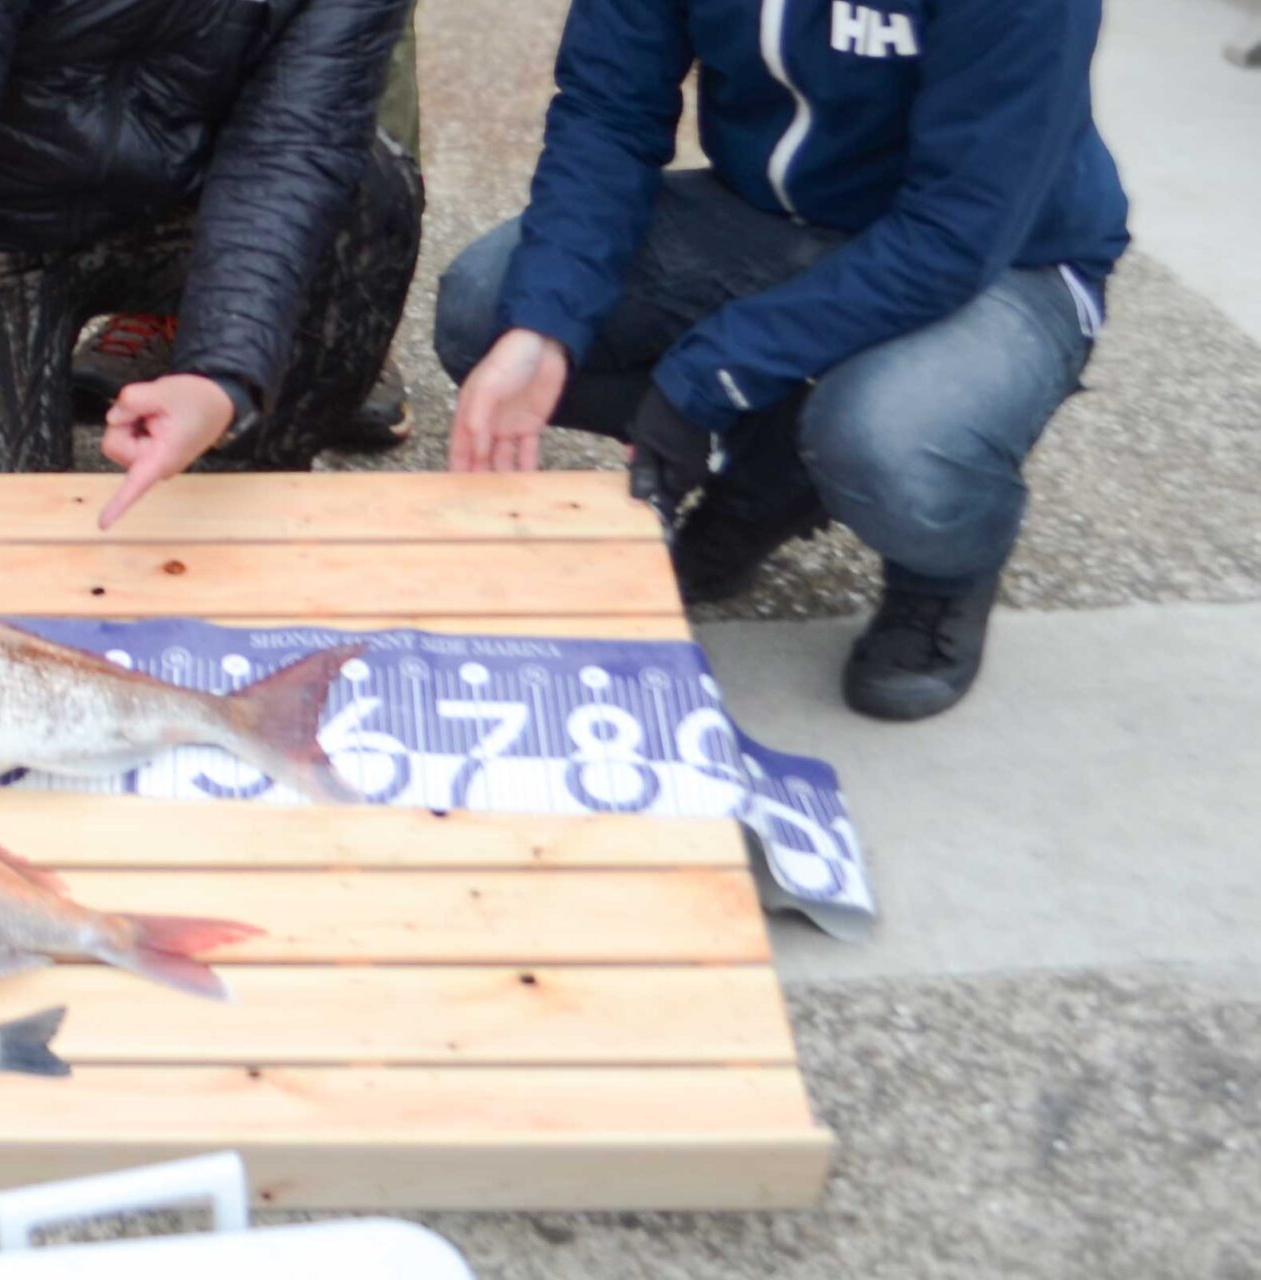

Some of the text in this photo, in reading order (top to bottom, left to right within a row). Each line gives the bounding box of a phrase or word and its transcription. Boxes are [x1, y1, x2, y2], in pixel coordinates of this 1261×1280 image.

[830, 0, 919, 58] HH
[316, 696, 412, 805] 6
[437, 699, 529, 809] 7
[564, 702, 662, 814] 8
